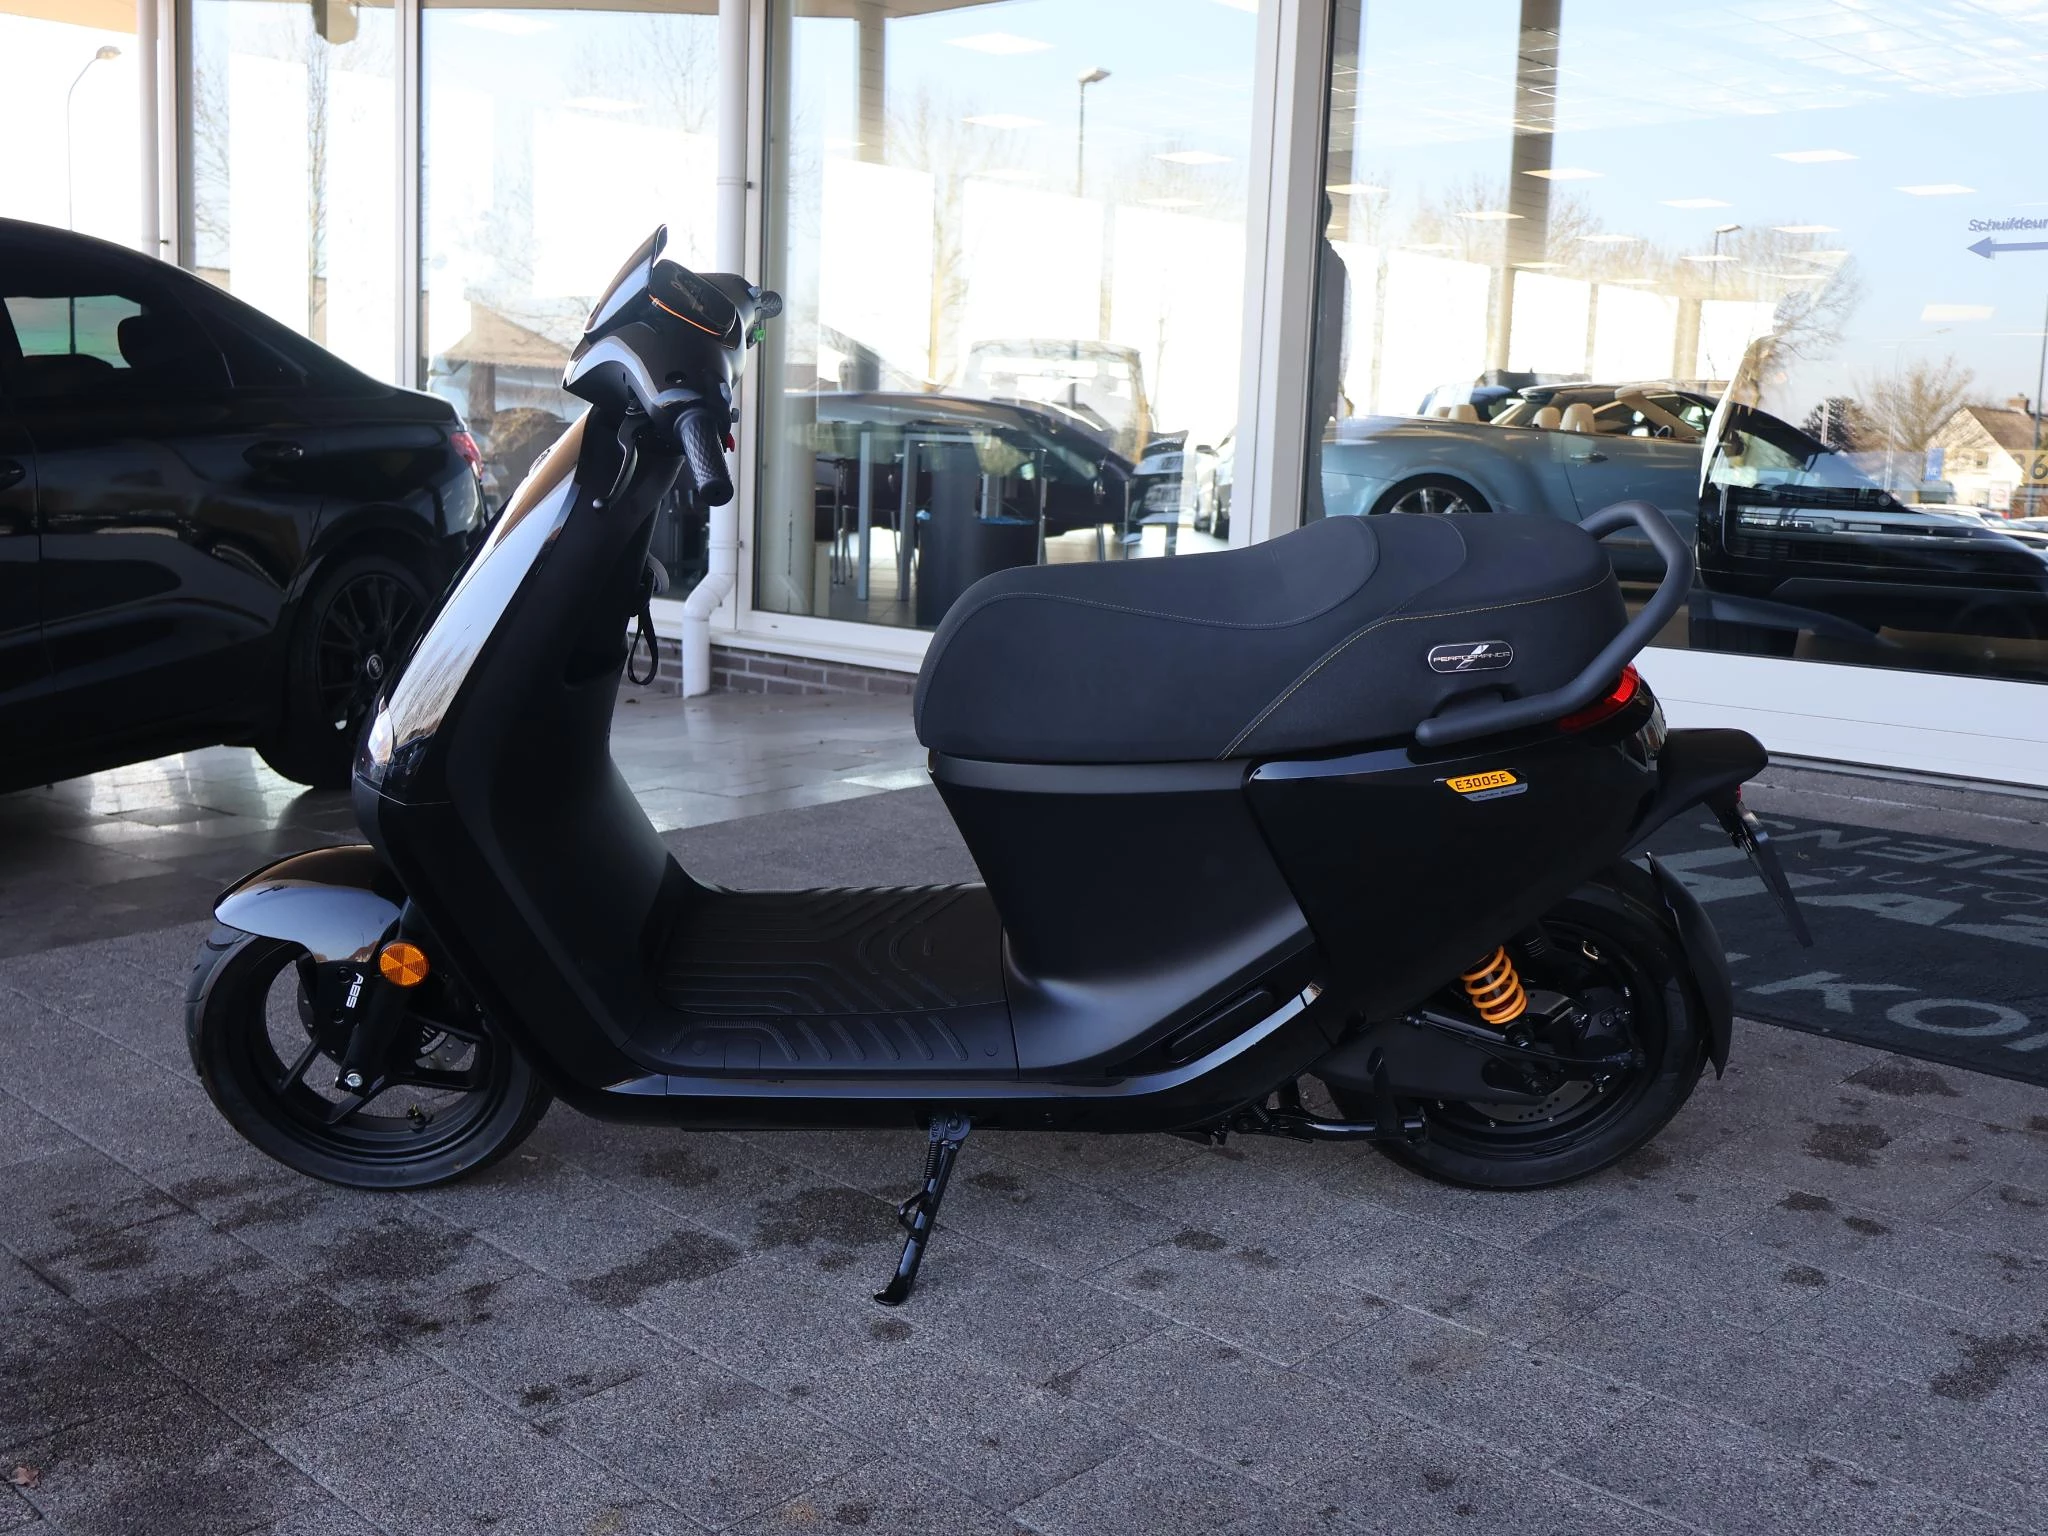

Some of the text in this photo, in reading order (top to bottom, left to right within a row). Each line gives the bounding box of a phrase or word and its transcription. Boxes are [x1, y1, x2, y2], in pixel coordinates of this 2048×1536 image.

[1433, 651, 1511, 663] PERFORMANCE
[1455, 773, 1508, 790] E300SE
[1812, 864, 2048, 905] AUTO
[345, 972, 364, 1009] ABS
